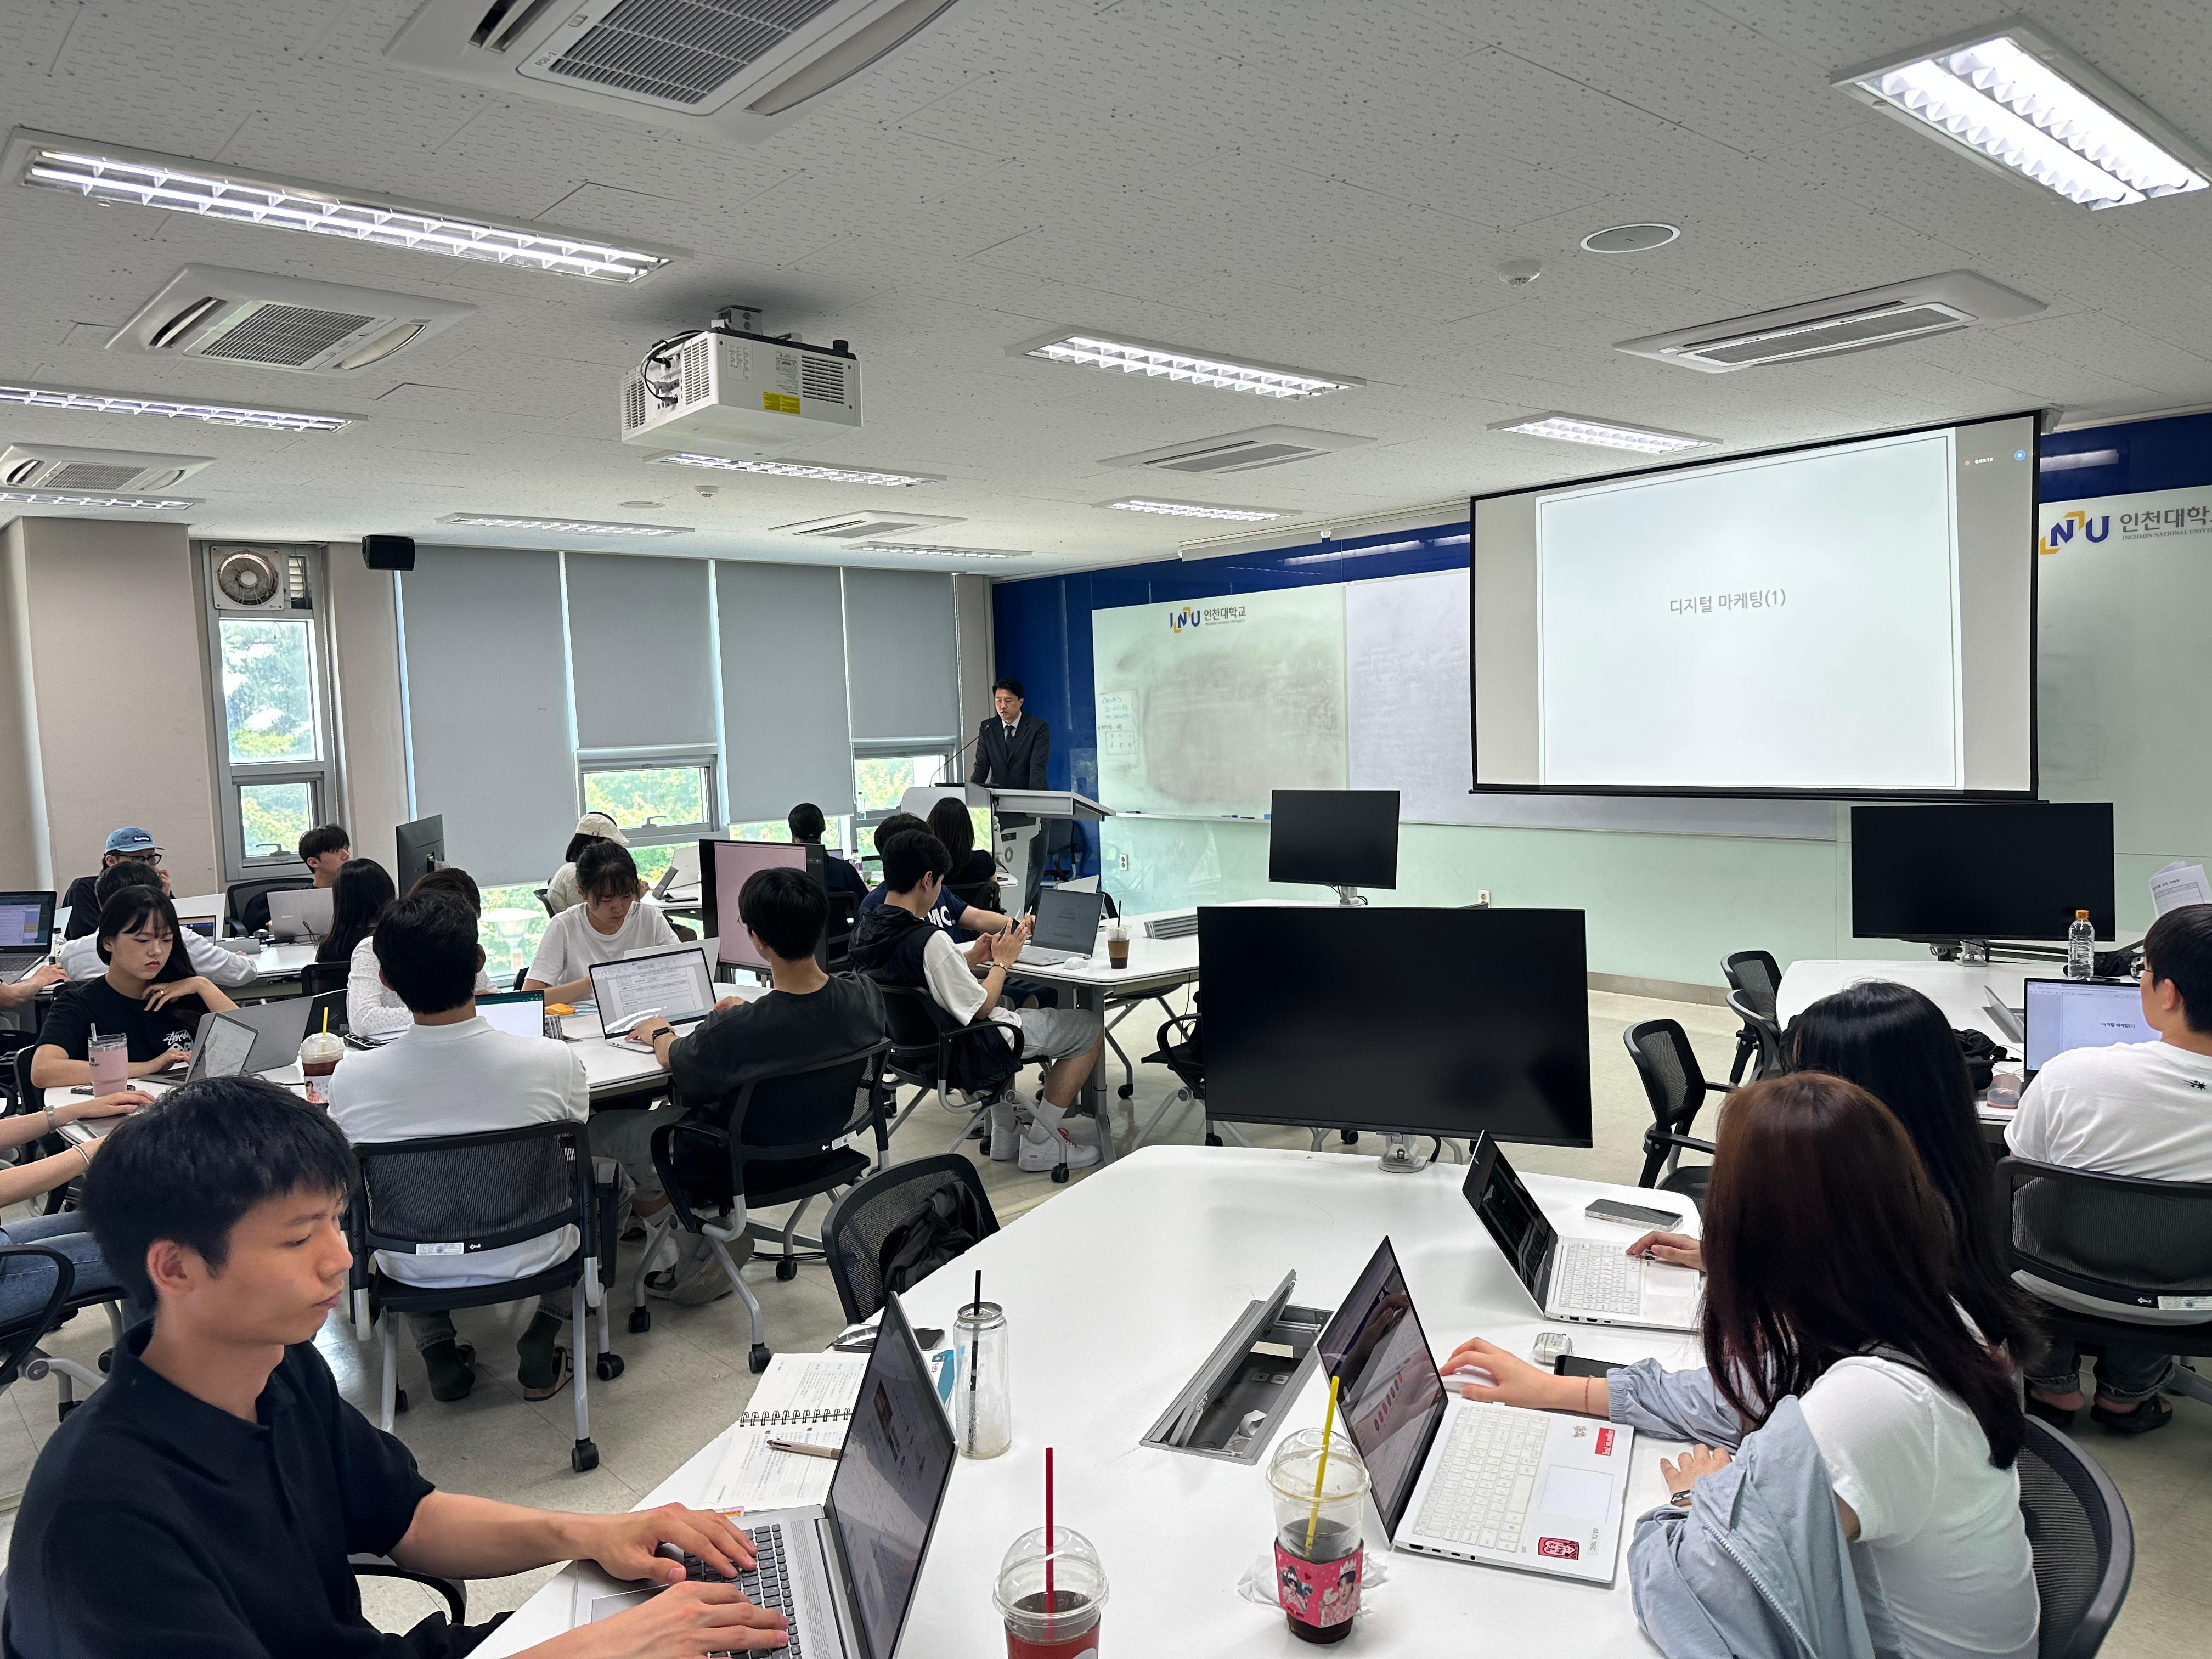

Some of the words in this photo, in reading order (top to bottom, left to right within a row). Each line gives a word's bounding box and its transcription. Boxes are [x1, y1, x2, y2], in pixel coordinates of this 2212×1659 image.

[2120, 505, 2212, 533] 인천대학
[2049, 514, 2111, 548] NU
[2153, 529, 2188, 537] NATIONAL
[1670, 595, 1712, 615] 디지털
[1718, 588, 1786, 611] 마케팅(1)
[1169, 610, 1201, 629] INU
[1204, 606, 1246, 621] 인천대학교
